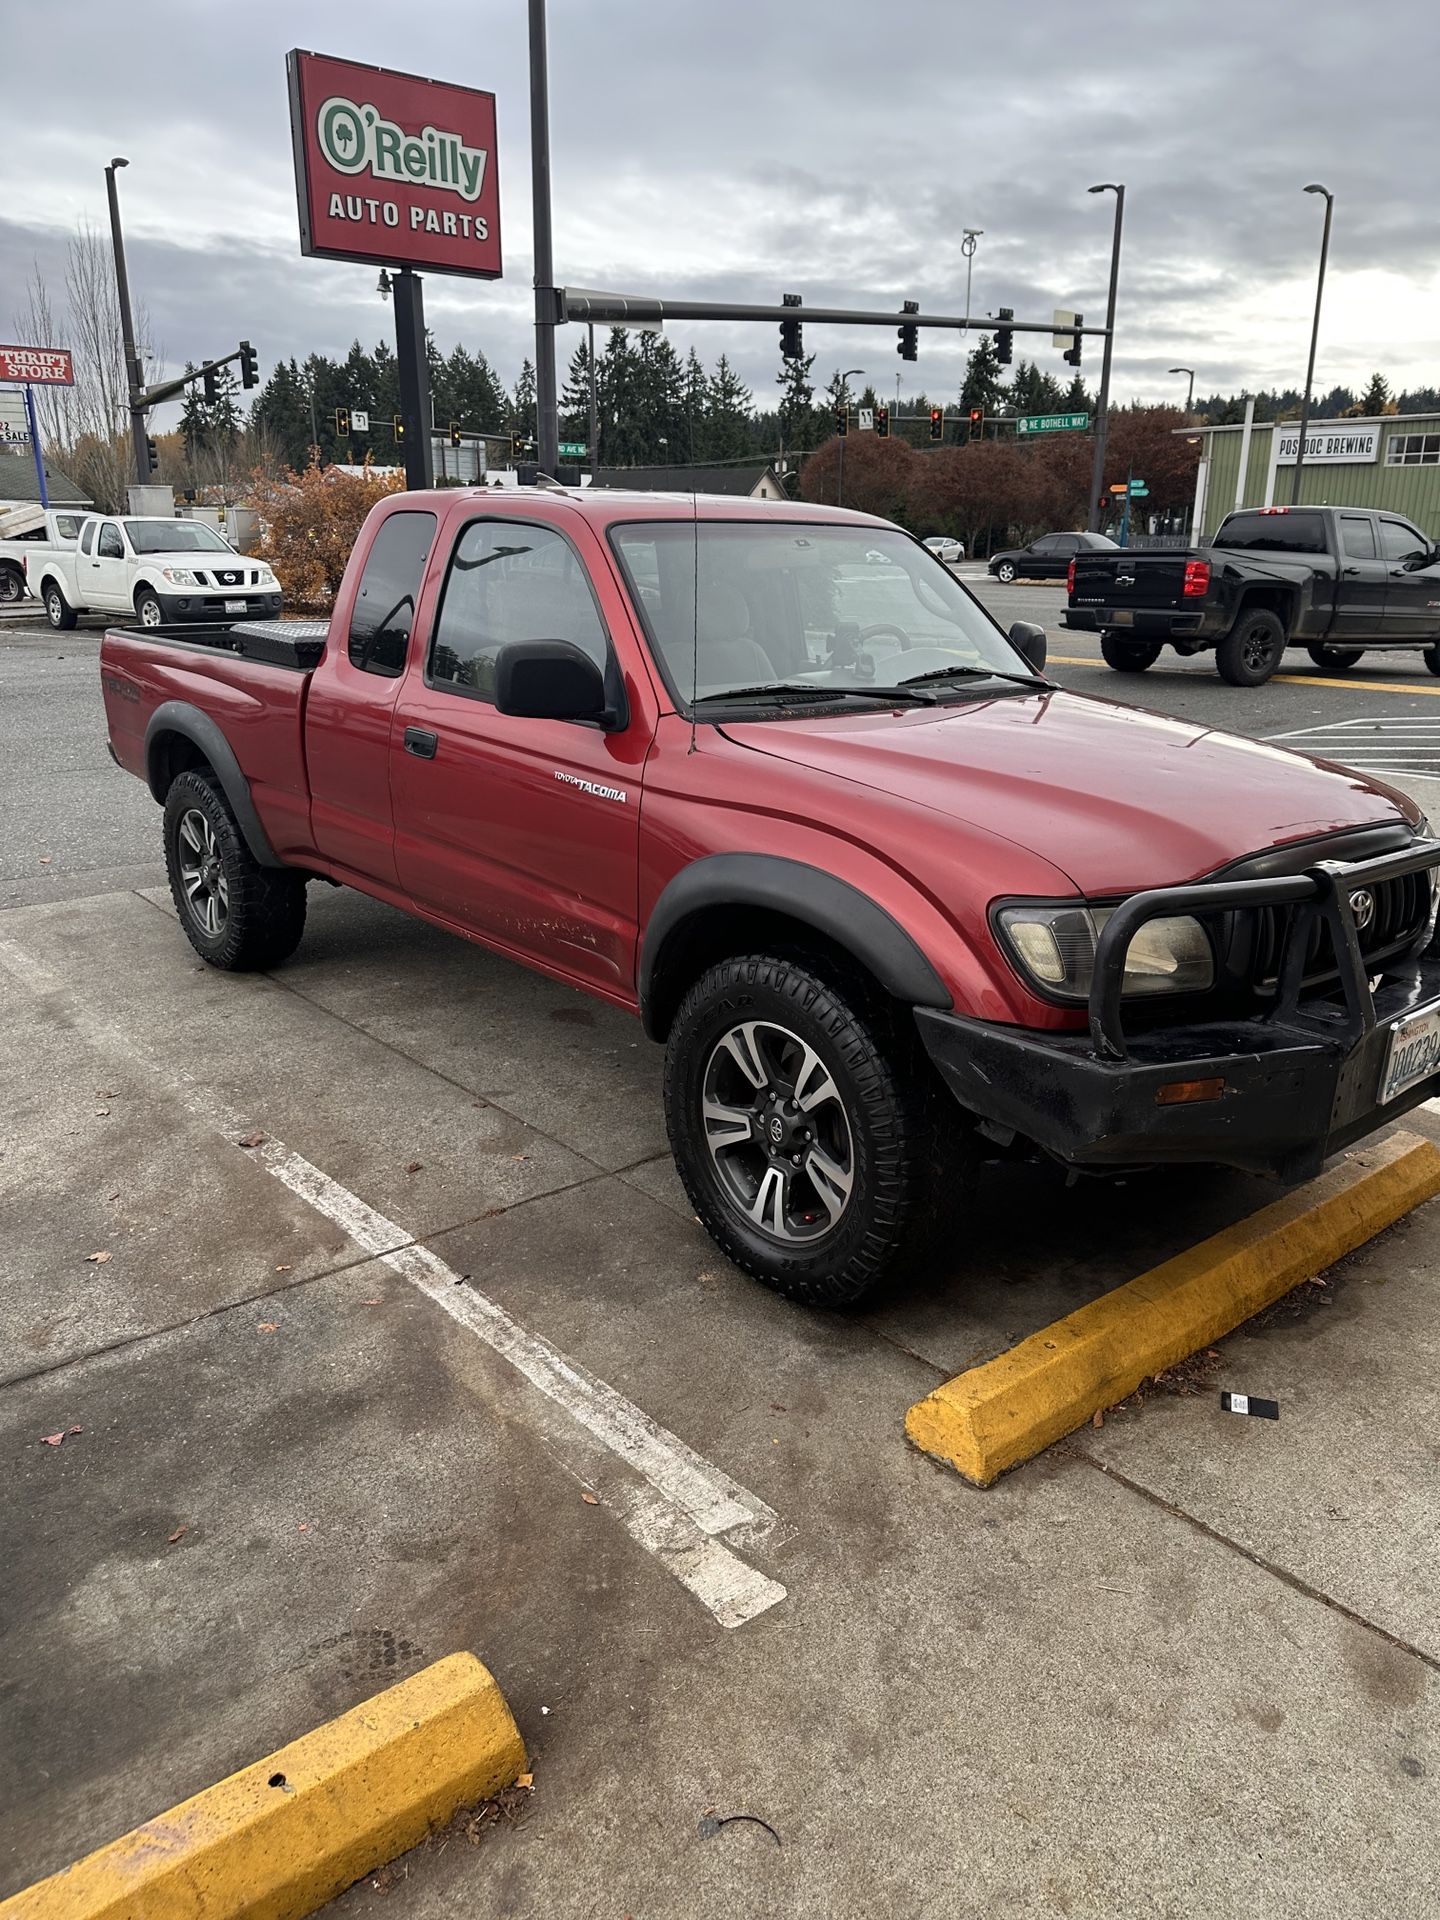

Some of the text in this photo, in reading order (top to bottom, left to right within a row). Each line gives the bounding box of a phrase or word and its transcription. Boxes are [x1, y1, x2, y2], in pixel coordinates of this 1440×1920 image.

[324, 104, 481, 195] O'Reilly
[330, 194, 488, 239] AUTO PARTS
[0, 351, 68, 367] THRIFT
[8, 364, 66, 379] STORE
[1029, 416, 1085, 429] NE BOTHELL WAY
[5, 432, 29, 441] SALE
[1327, 436, 1373, 454] BREWING
[554, 771, 626, 802] TOYOTA TACOMA
